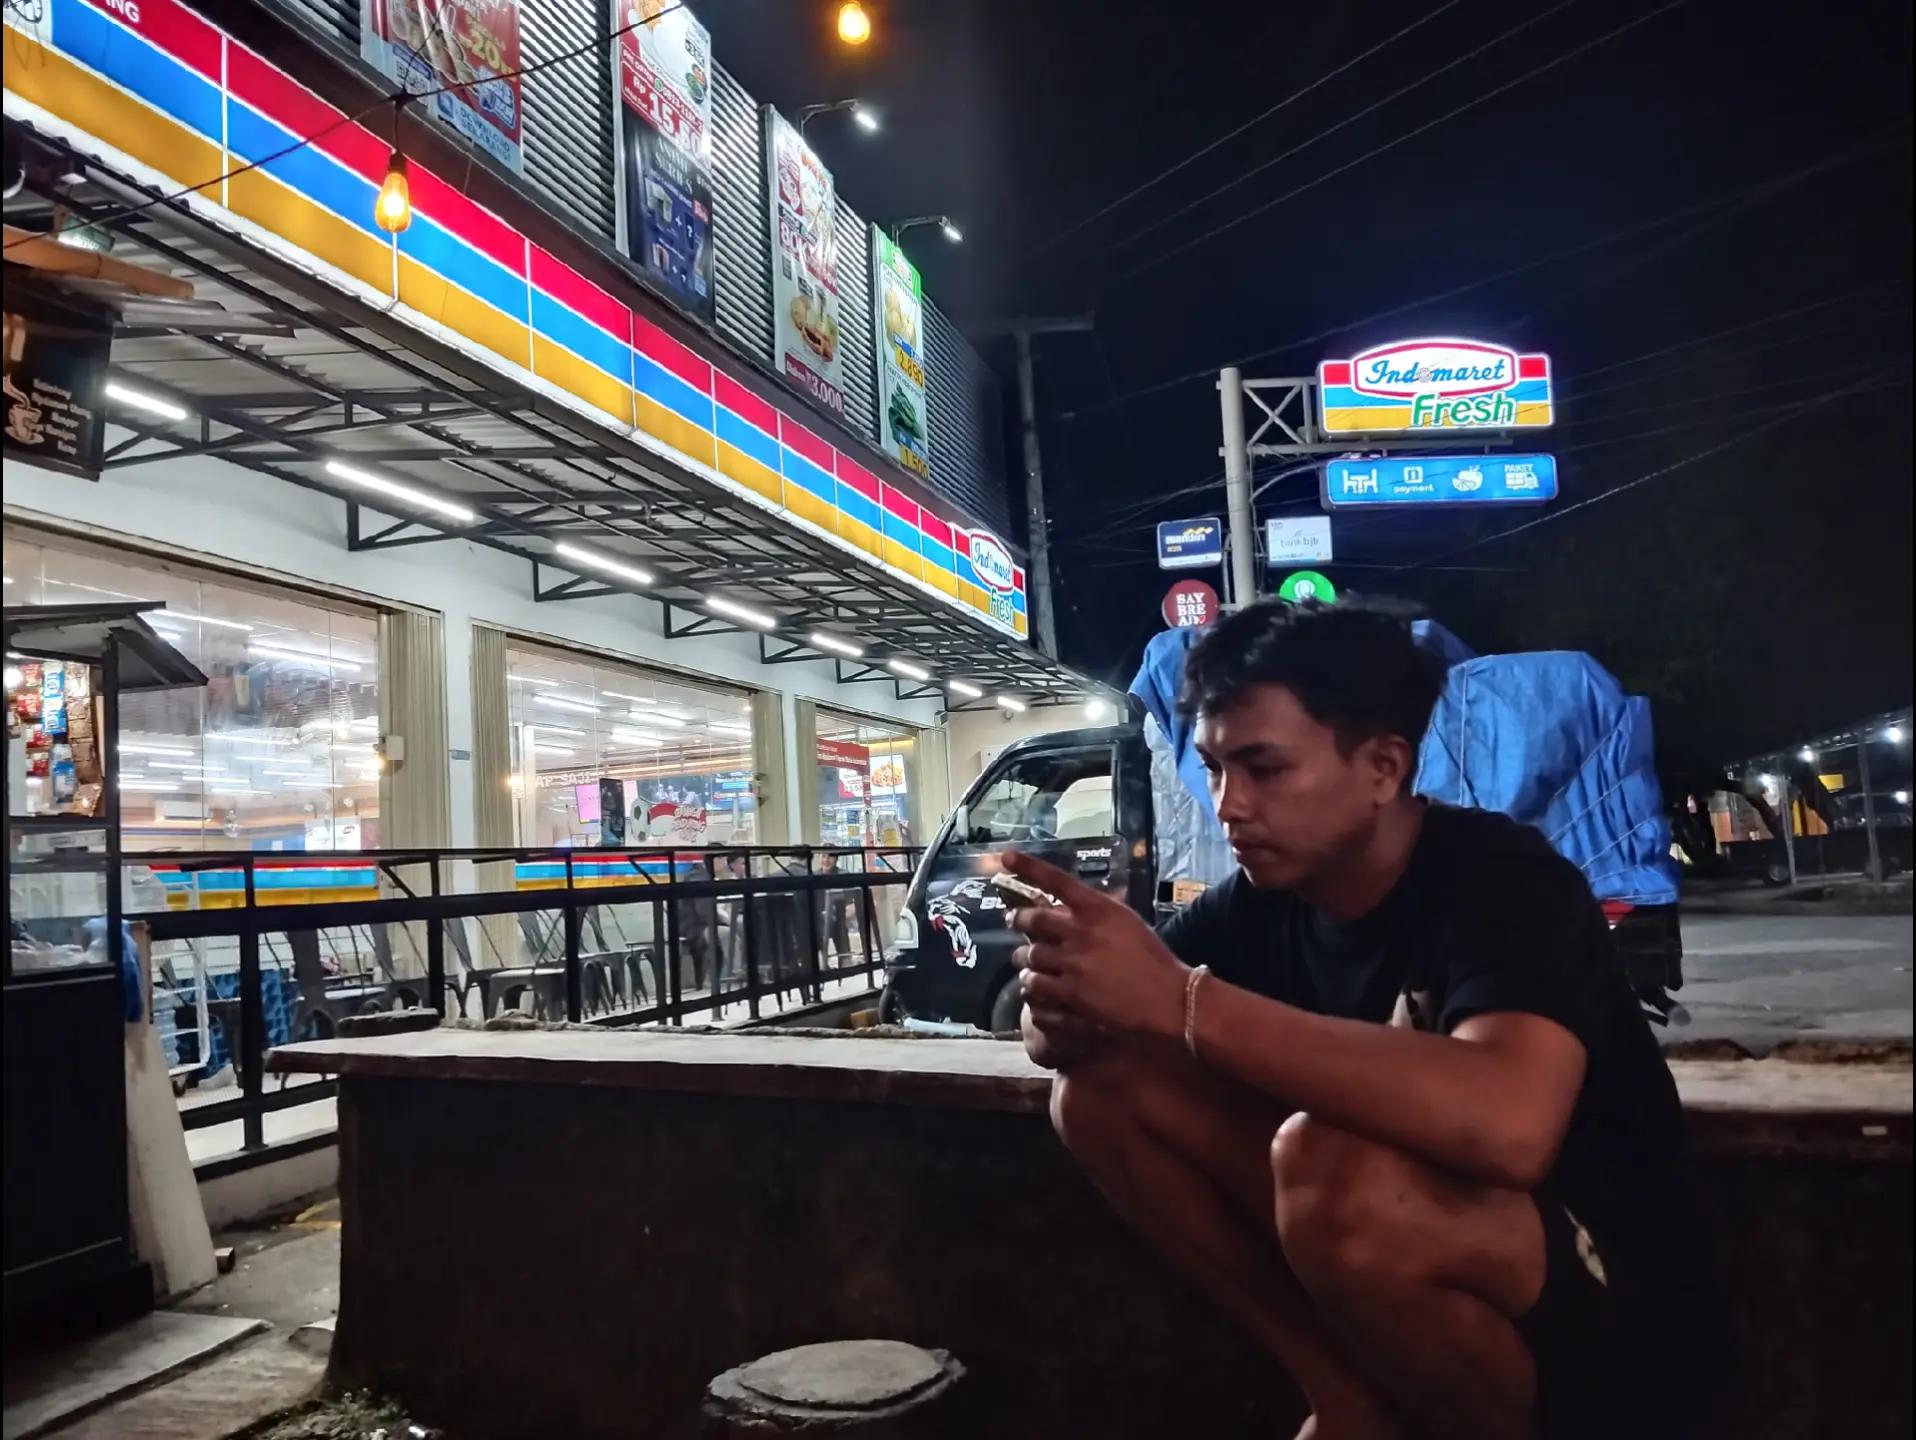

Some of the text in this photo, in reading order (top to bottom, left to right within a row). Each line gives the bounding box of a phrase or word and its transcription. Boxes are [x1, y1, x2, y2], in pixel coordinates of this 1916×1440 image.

[900, 349, 924, 388] 2.890
[1365, 358, 1505, 384] Indomaret
[1413, 393, 1513, 426] Fresh
[1393, 483, 1434, 495] payment
[1176, 592, 1206, 604] SAY
[1177, 603, 1206, 616] BRE
[535, 775, 553, 788] AP
[1076, 847, 1113, 861] sports
